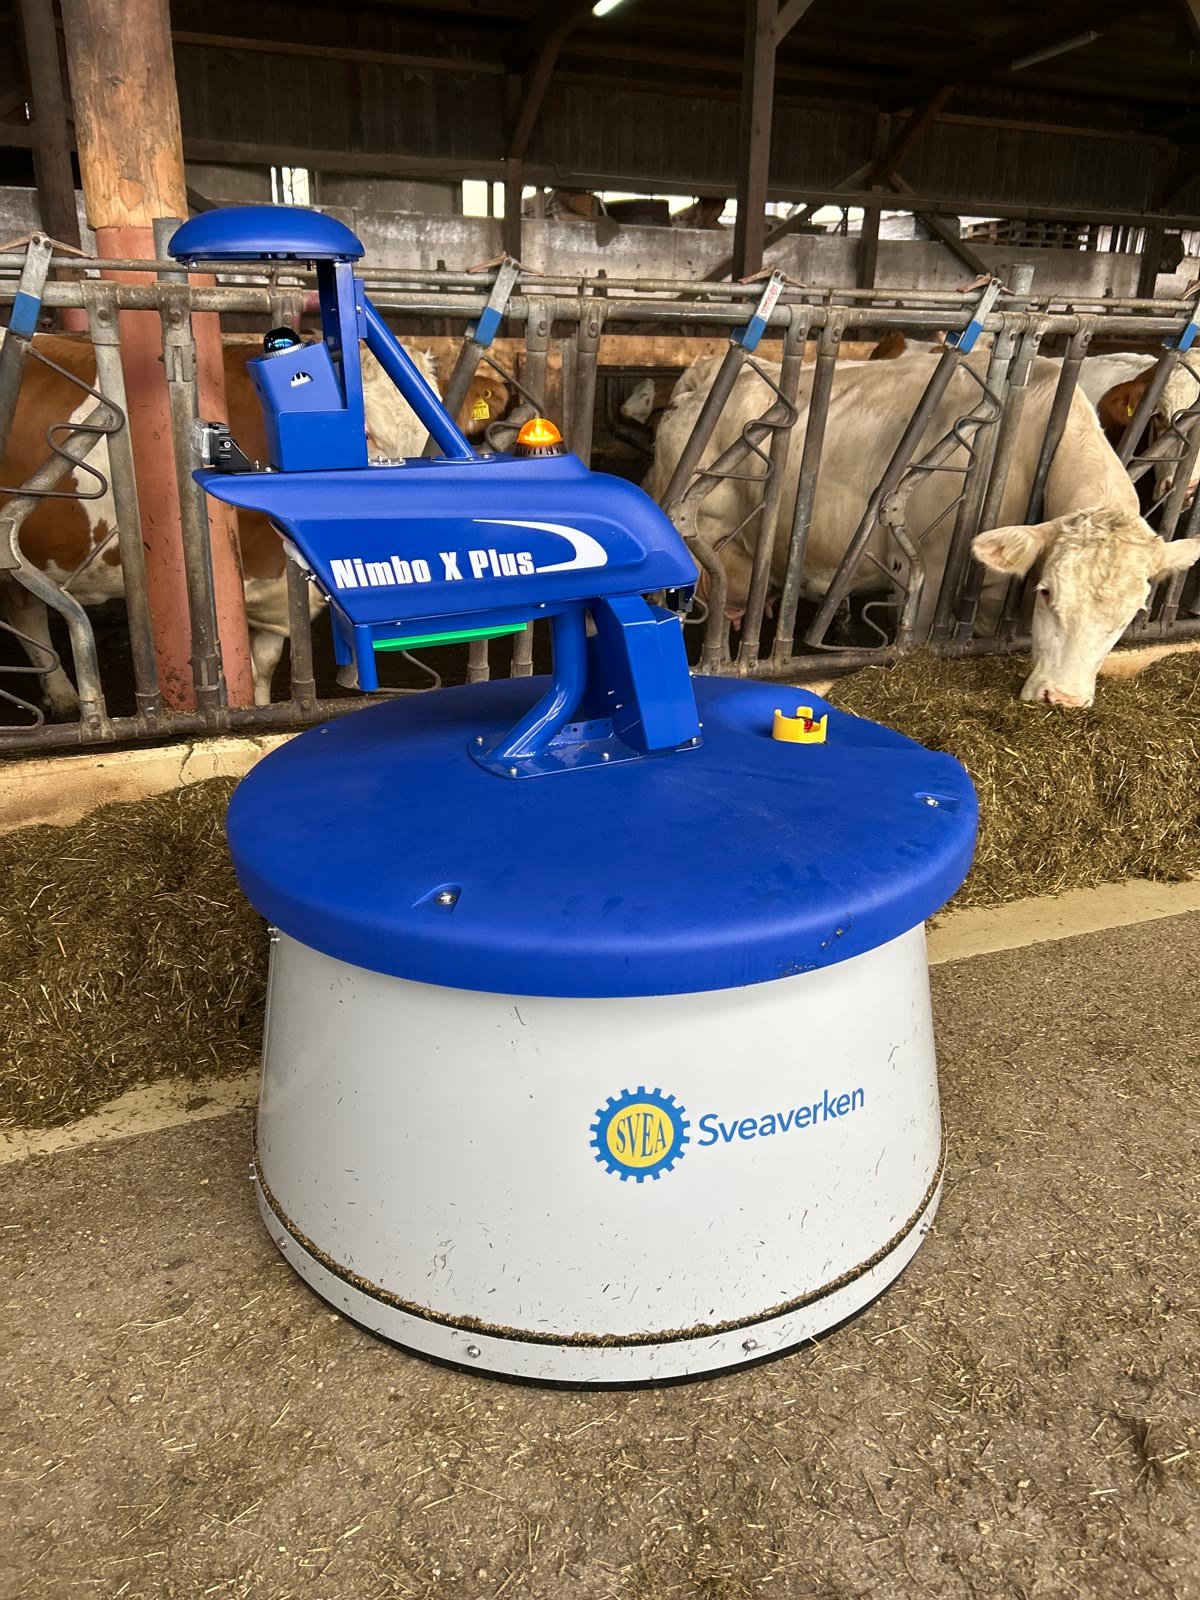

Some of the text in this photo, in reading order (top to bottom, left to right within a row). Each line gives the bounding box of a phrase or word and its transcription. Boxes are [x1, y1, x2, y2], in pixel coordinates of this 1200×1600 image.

[330, 548, 535, 589] Nimbo X Plus
[616, 1112, 667, 1158] SVEA
[697, 1087, 865, 1147] Sveaverken
